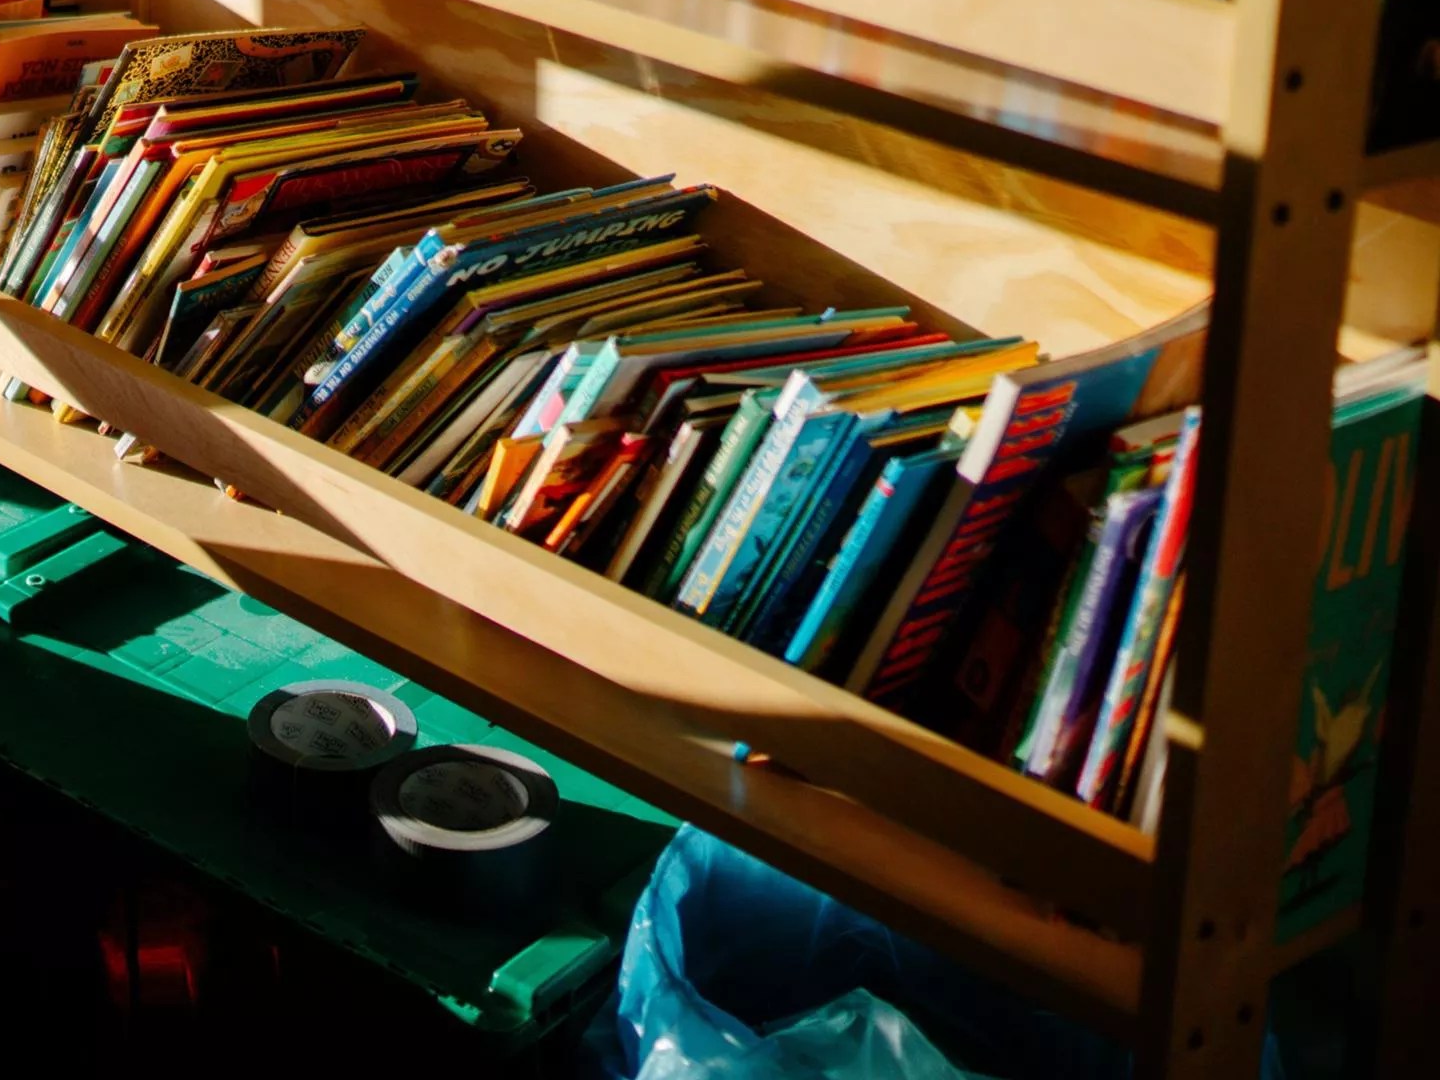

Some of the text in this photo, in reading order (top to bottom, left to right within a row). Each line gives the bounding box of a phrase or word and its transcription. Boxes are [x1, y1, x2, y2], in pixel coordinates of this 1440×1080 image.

[445, 254, 510, 288] NO
[514, 209, 686, 265] JUMPING
[347, 321, 388, 364] JUMPING
[336, 360, 352, 377] ON
